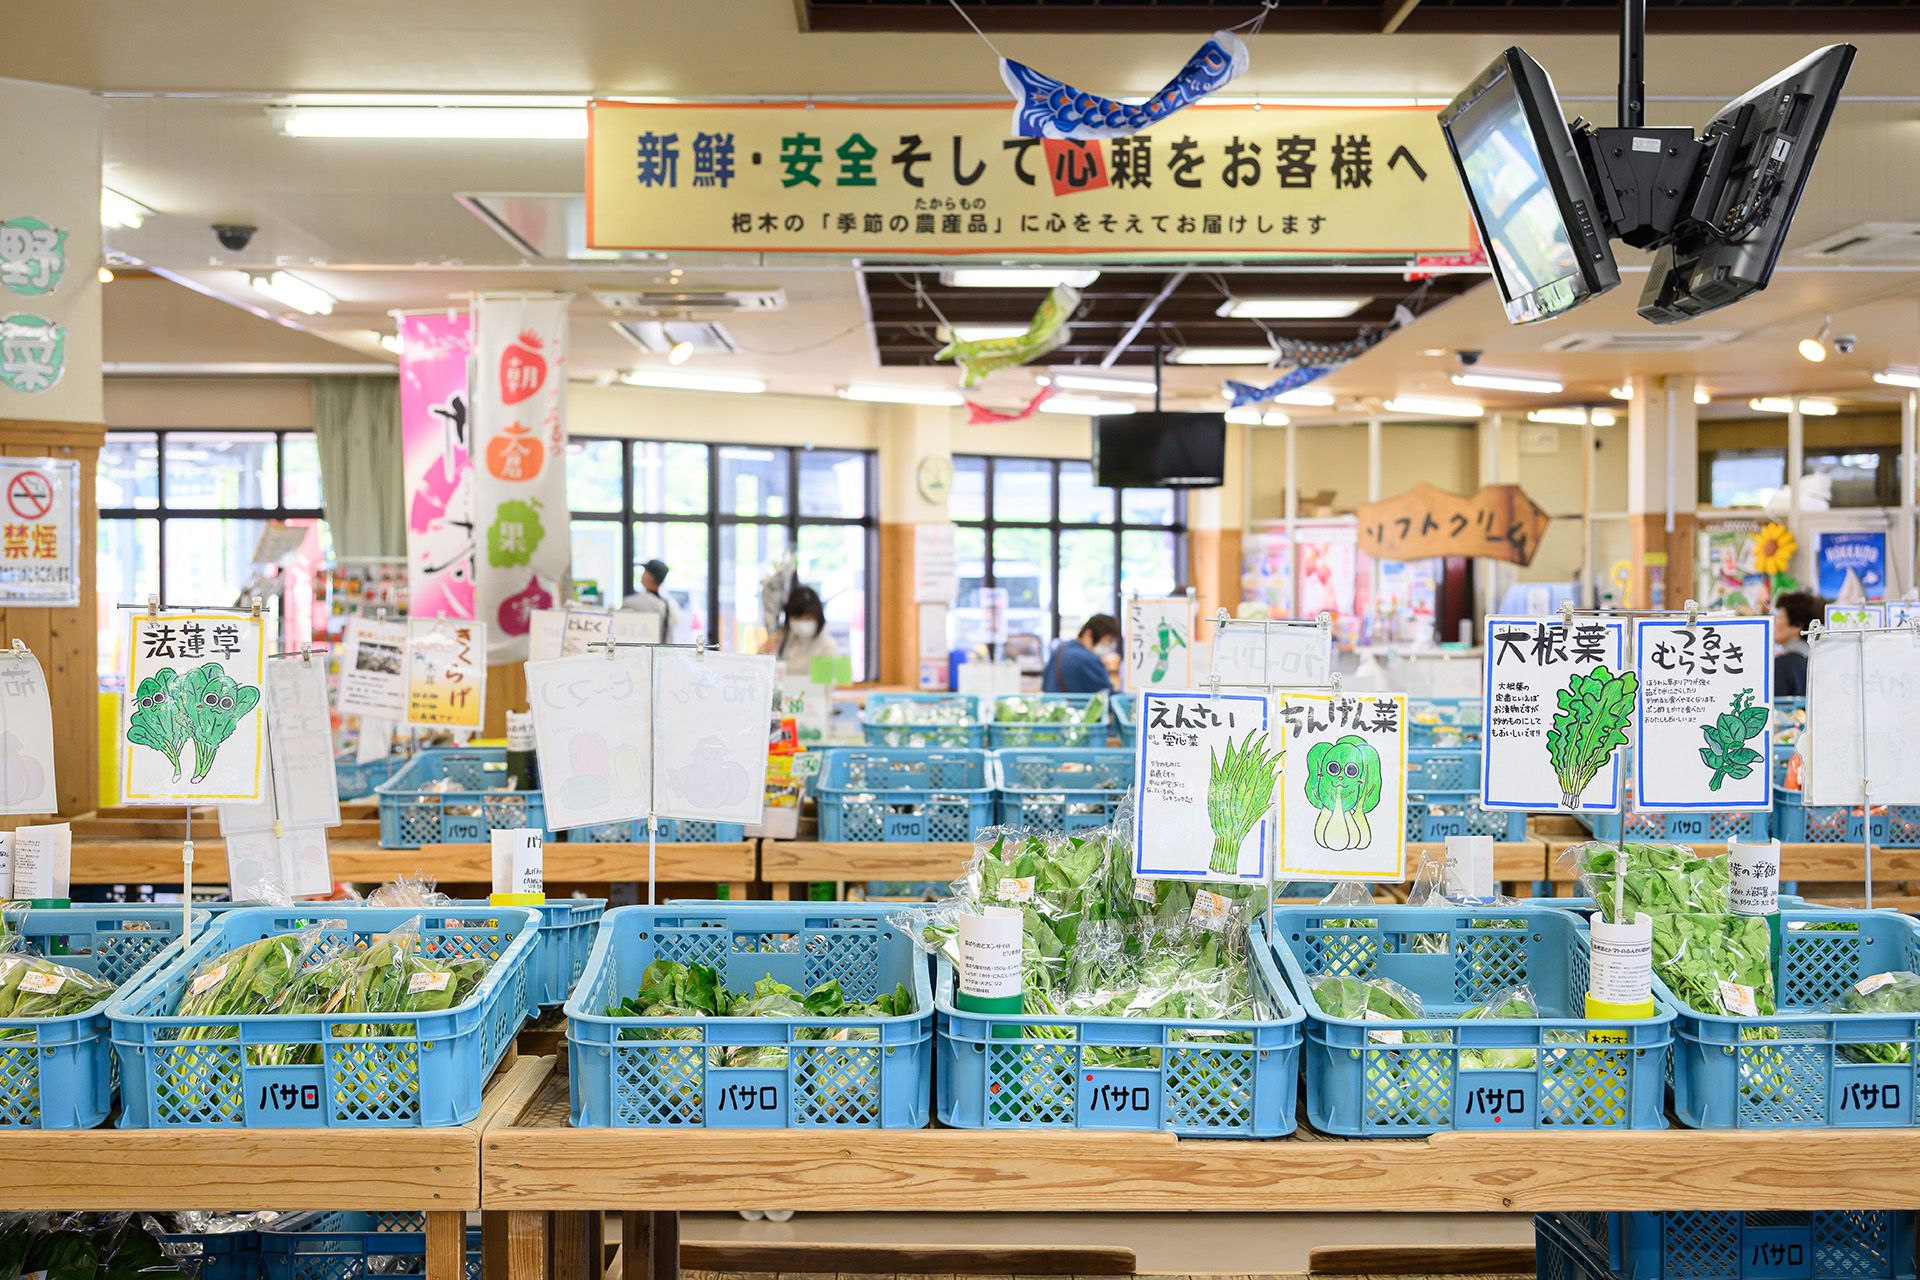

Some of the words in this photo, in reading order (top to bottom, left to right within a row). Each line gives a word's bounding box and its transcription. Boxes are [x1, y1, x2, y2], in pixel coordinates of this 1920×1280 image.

[914, 197, 986, 211] たからもの
[731, 212, 1327, 235] 杷木の「季節の農産品」に心をそえてお届けします
[3, 523, 58, 560] 禁煙
[1366, 510, 1527, 567] ソフトクリーム
[143, 623, 241, 660] 法蓮草
[1494, 623, 1607, 666] 大根葉
[1671, 627, 1721, 650] つる
[446, 628, 472, 708] きくらげ
[1652, 641, 1744, 675] むらさき
[1496, 693, 1540, 703] 定番といえば
[1498, 682, 1530, 691] 大根葉の
[1150, 700, 1235, 729] えんさい
[1279, 697, 1400, 738] ちんげん菜
[1494, 704, 1540, 714] お漬物ですが
[1493, 717, 1541, 725] 炒めものにして
[1162, 732, 1198, 747] 空心菜
[449, 824, 478, 840] バサロ
[639, 823, 669, 838] バロ
[890, 823, 921, 837] バサロ
[1431, 823, 1460, 836] バサロ
[1671, 820, 1702, 834] バサロ
[1853, 823, 1883, 837] バロ
[260, 1084, 319, 1110] バサロ
[718, 1085, 777, 1111] バサロ
[1090, 1085, 1151, 1112] バサロ
[1466, 1087, 1525, 1115] バサロ
[1840, 1084, 1900, 1111] バサロ
[1752, 1243, 1803, 1267] バサロ
